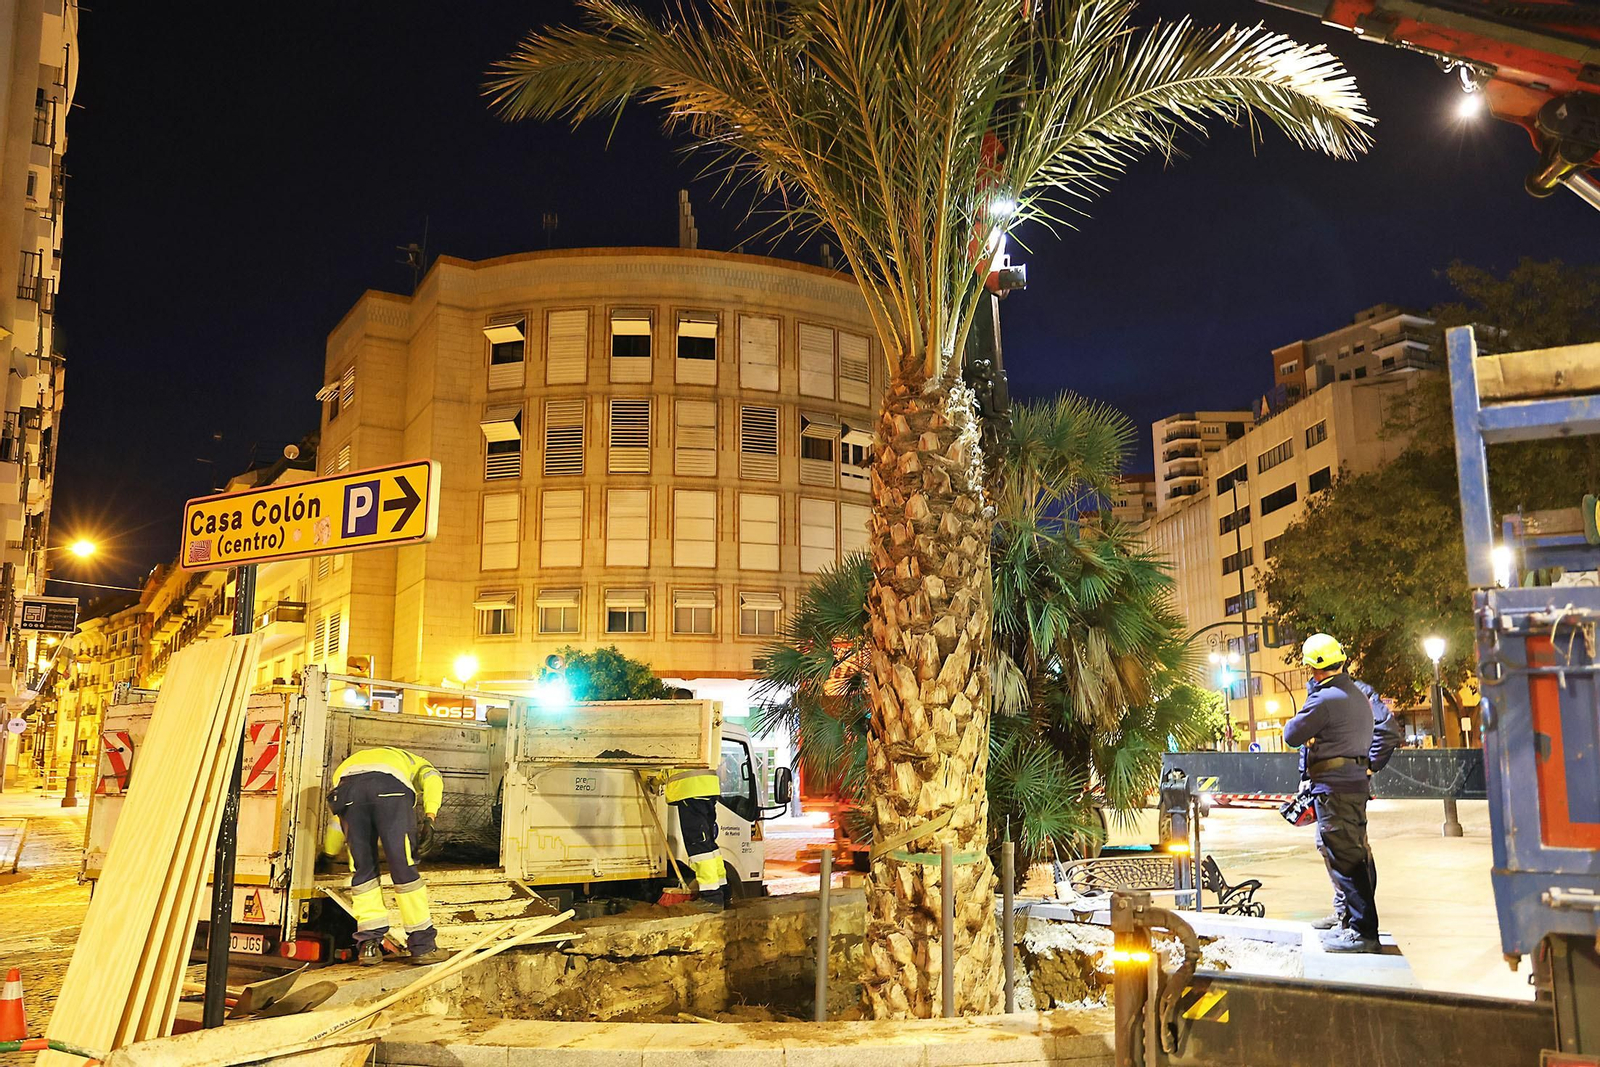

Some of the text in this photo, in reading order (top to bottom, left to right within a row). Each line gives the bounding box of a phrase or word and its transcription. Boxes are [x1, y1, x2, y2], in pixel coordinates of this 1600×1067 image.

[190, 493, 321, 536] Casa Colón
[346, 486, 373, 534] P
[217, 526, 285, 557] (centro)
[243, 936, 261, 951] JGS
